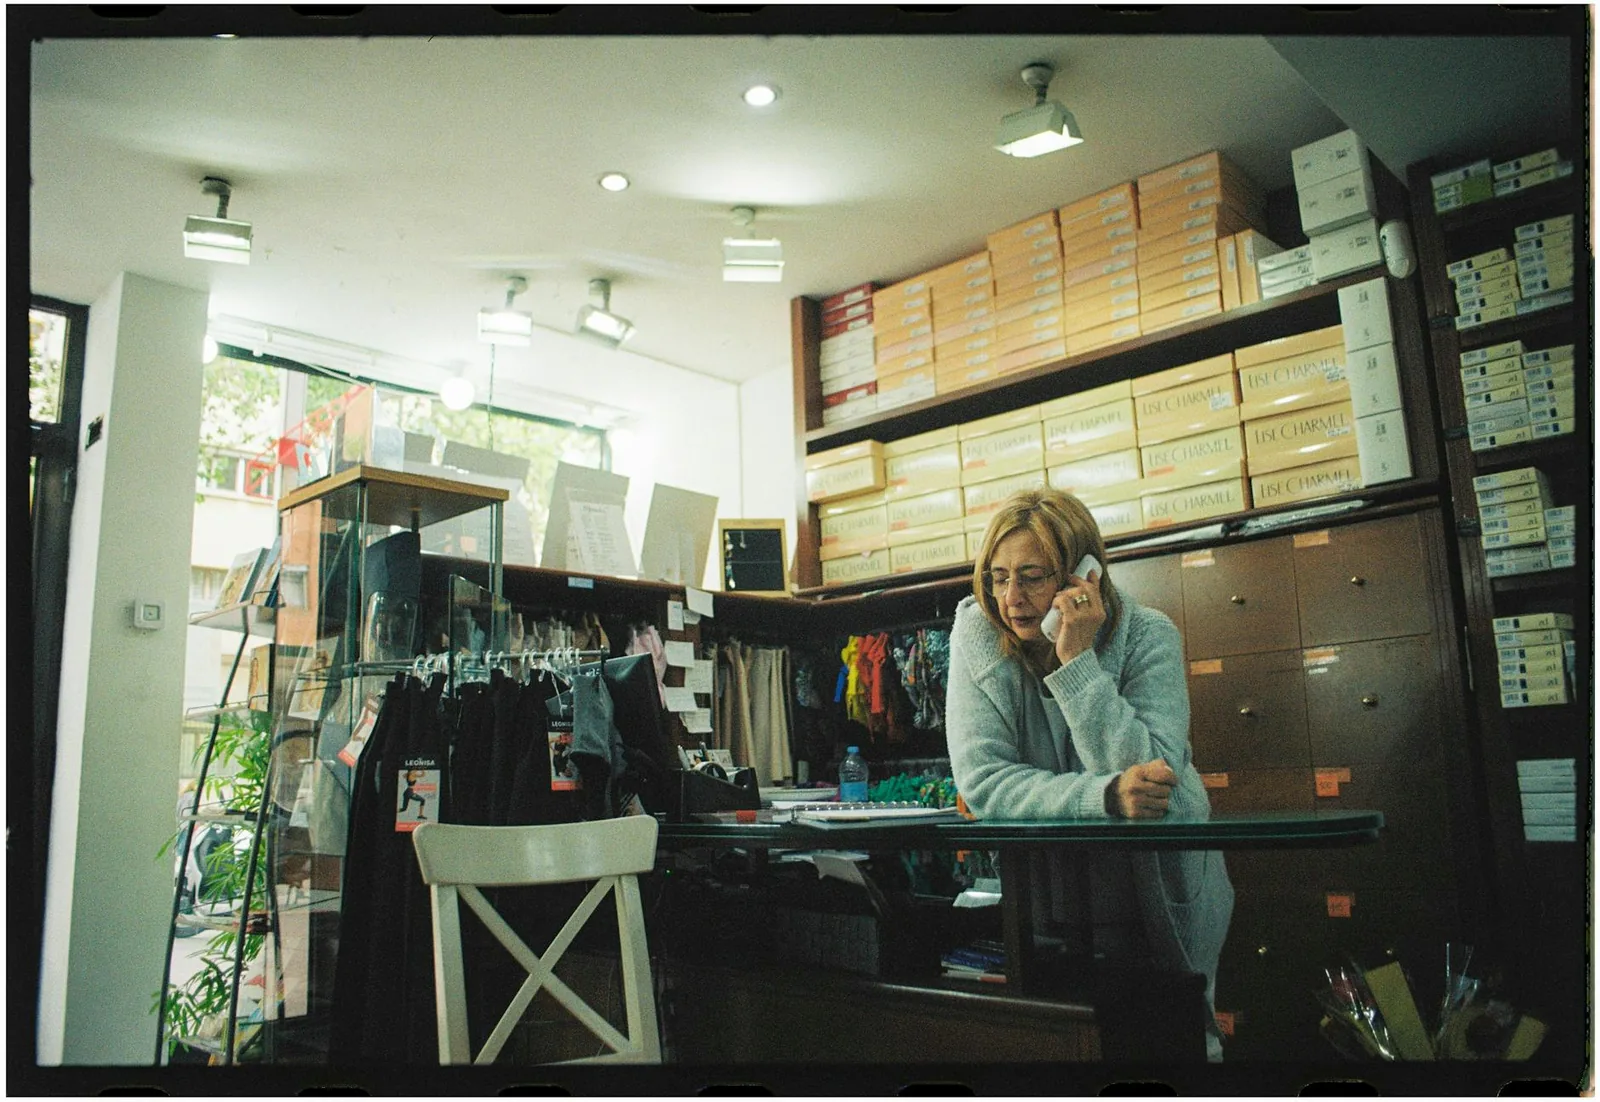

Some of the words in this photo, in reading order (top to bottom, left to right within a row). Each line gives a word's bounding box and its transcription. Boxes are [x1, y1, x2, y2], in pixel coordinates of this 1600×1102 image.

[1248, 372, 1271, 389] LISE
[1274, 357, 1338, 385] CHARMEL
[1143, 400, 1162, 416] LISE
[1165, 386, 1223, 412] CHARMEL
[1254, 428, 1276, 445] LISE
[1280, 413, 1349, 440] CHARMEL
[1149, 453, 1168, 468] LISE
[1172, 438, 1233, 464] CHARMEL
[1260, 482, 1282, 499] LISE
[1286, 469, 1355, 494] CHARMEL
[1150, 503, 1169, 518] LISE
[1173, 490, 1234, 514] CHARMEL
[405, 759, 436, 767] LEONISA
